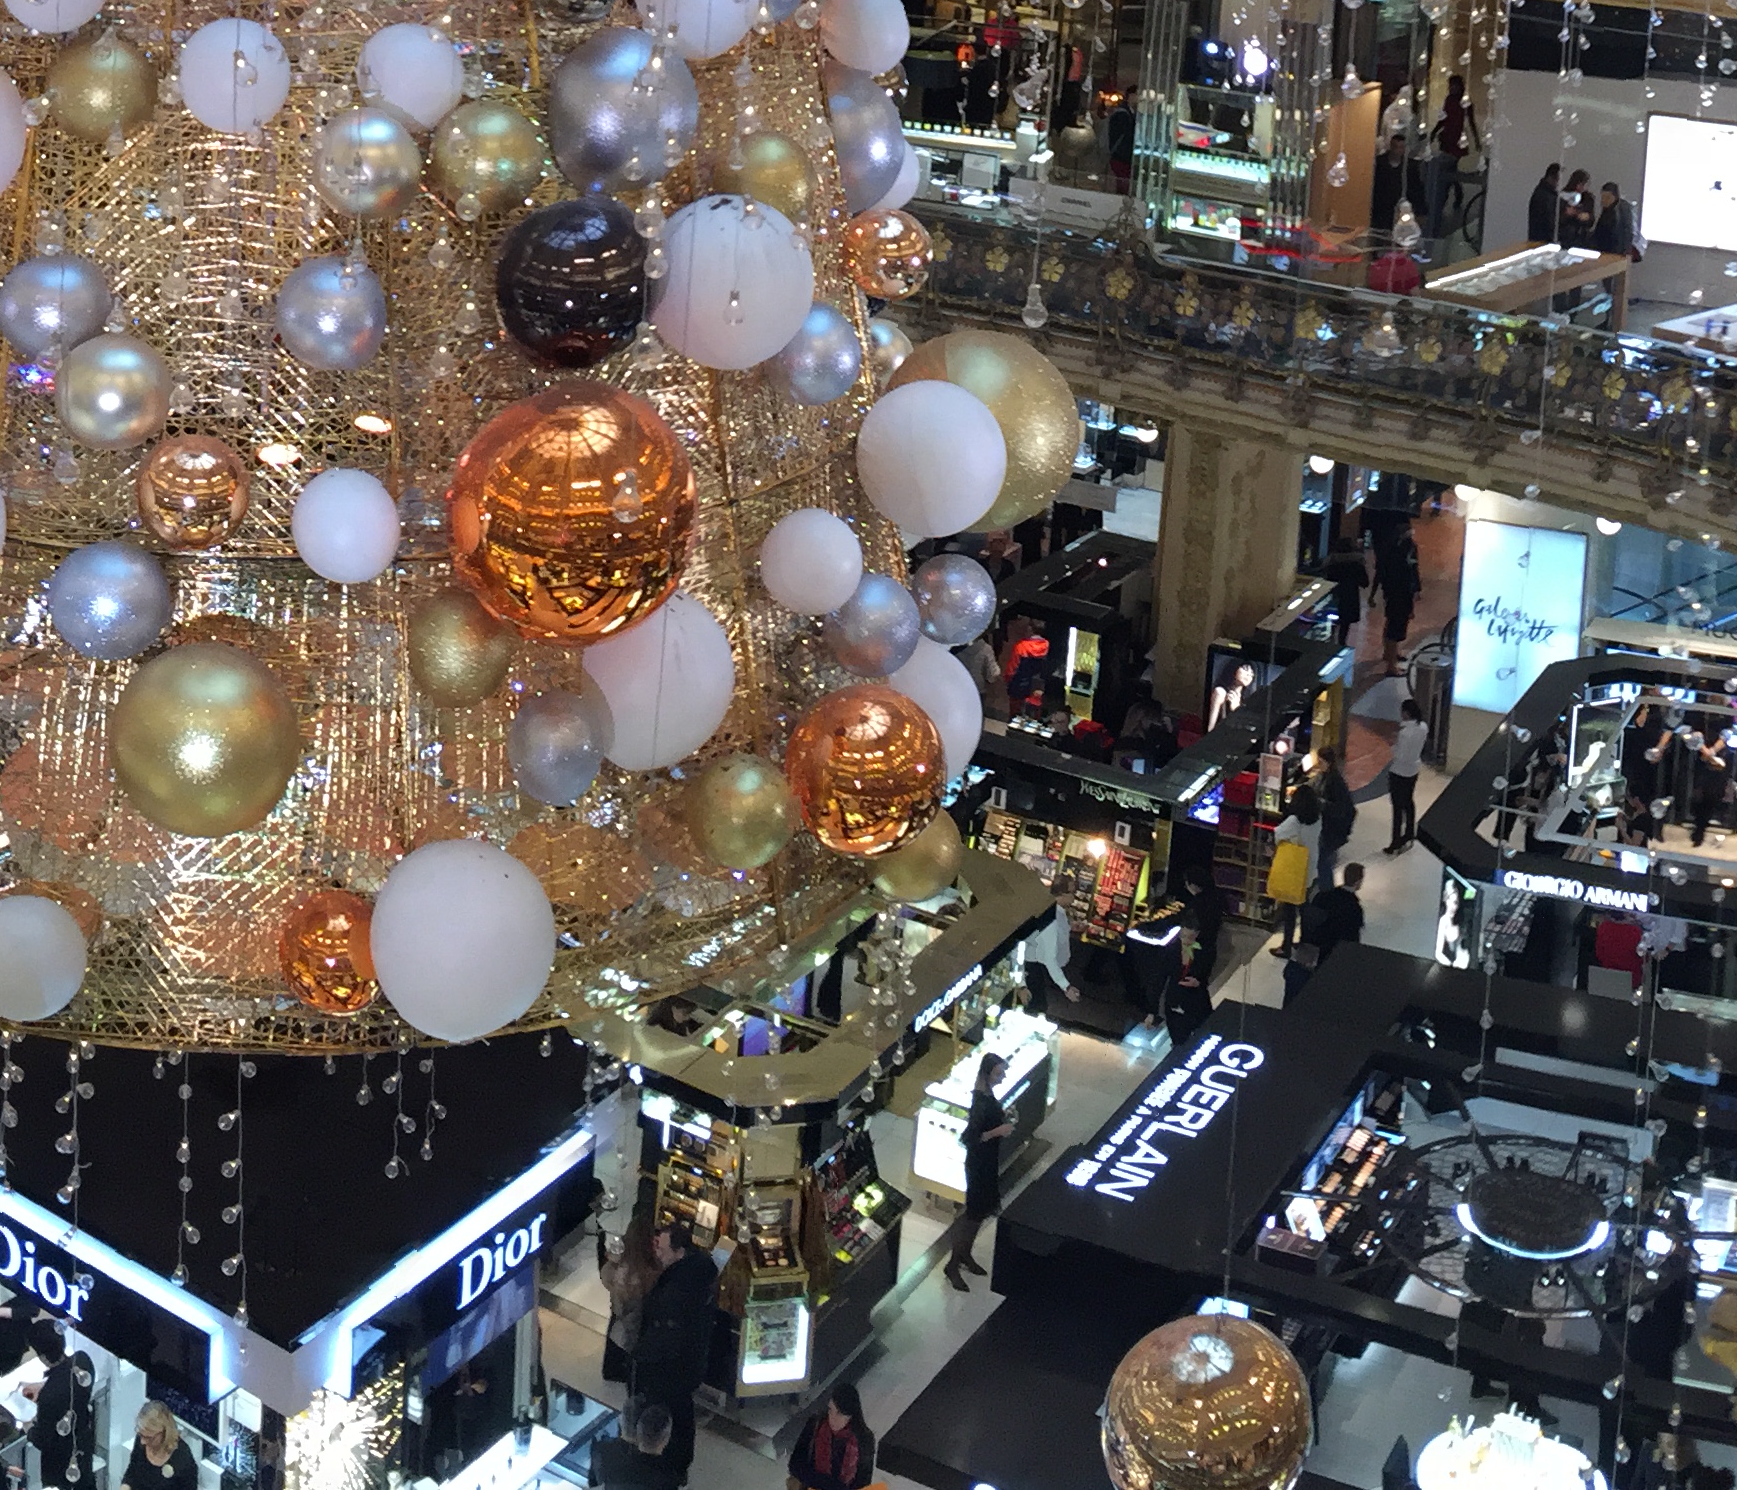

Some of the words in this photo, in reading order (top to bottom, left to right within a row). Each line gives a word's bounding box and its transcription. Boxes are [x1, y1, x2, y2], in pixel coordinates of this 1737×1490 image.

[1503, 870, 1584, 899] GIORGIO
[1583, 885, 1649, 913] ARMANI
[1094, 1043, 1265, 1202] GUERLAIN
[456, 1212, 548, 1311] Dior
